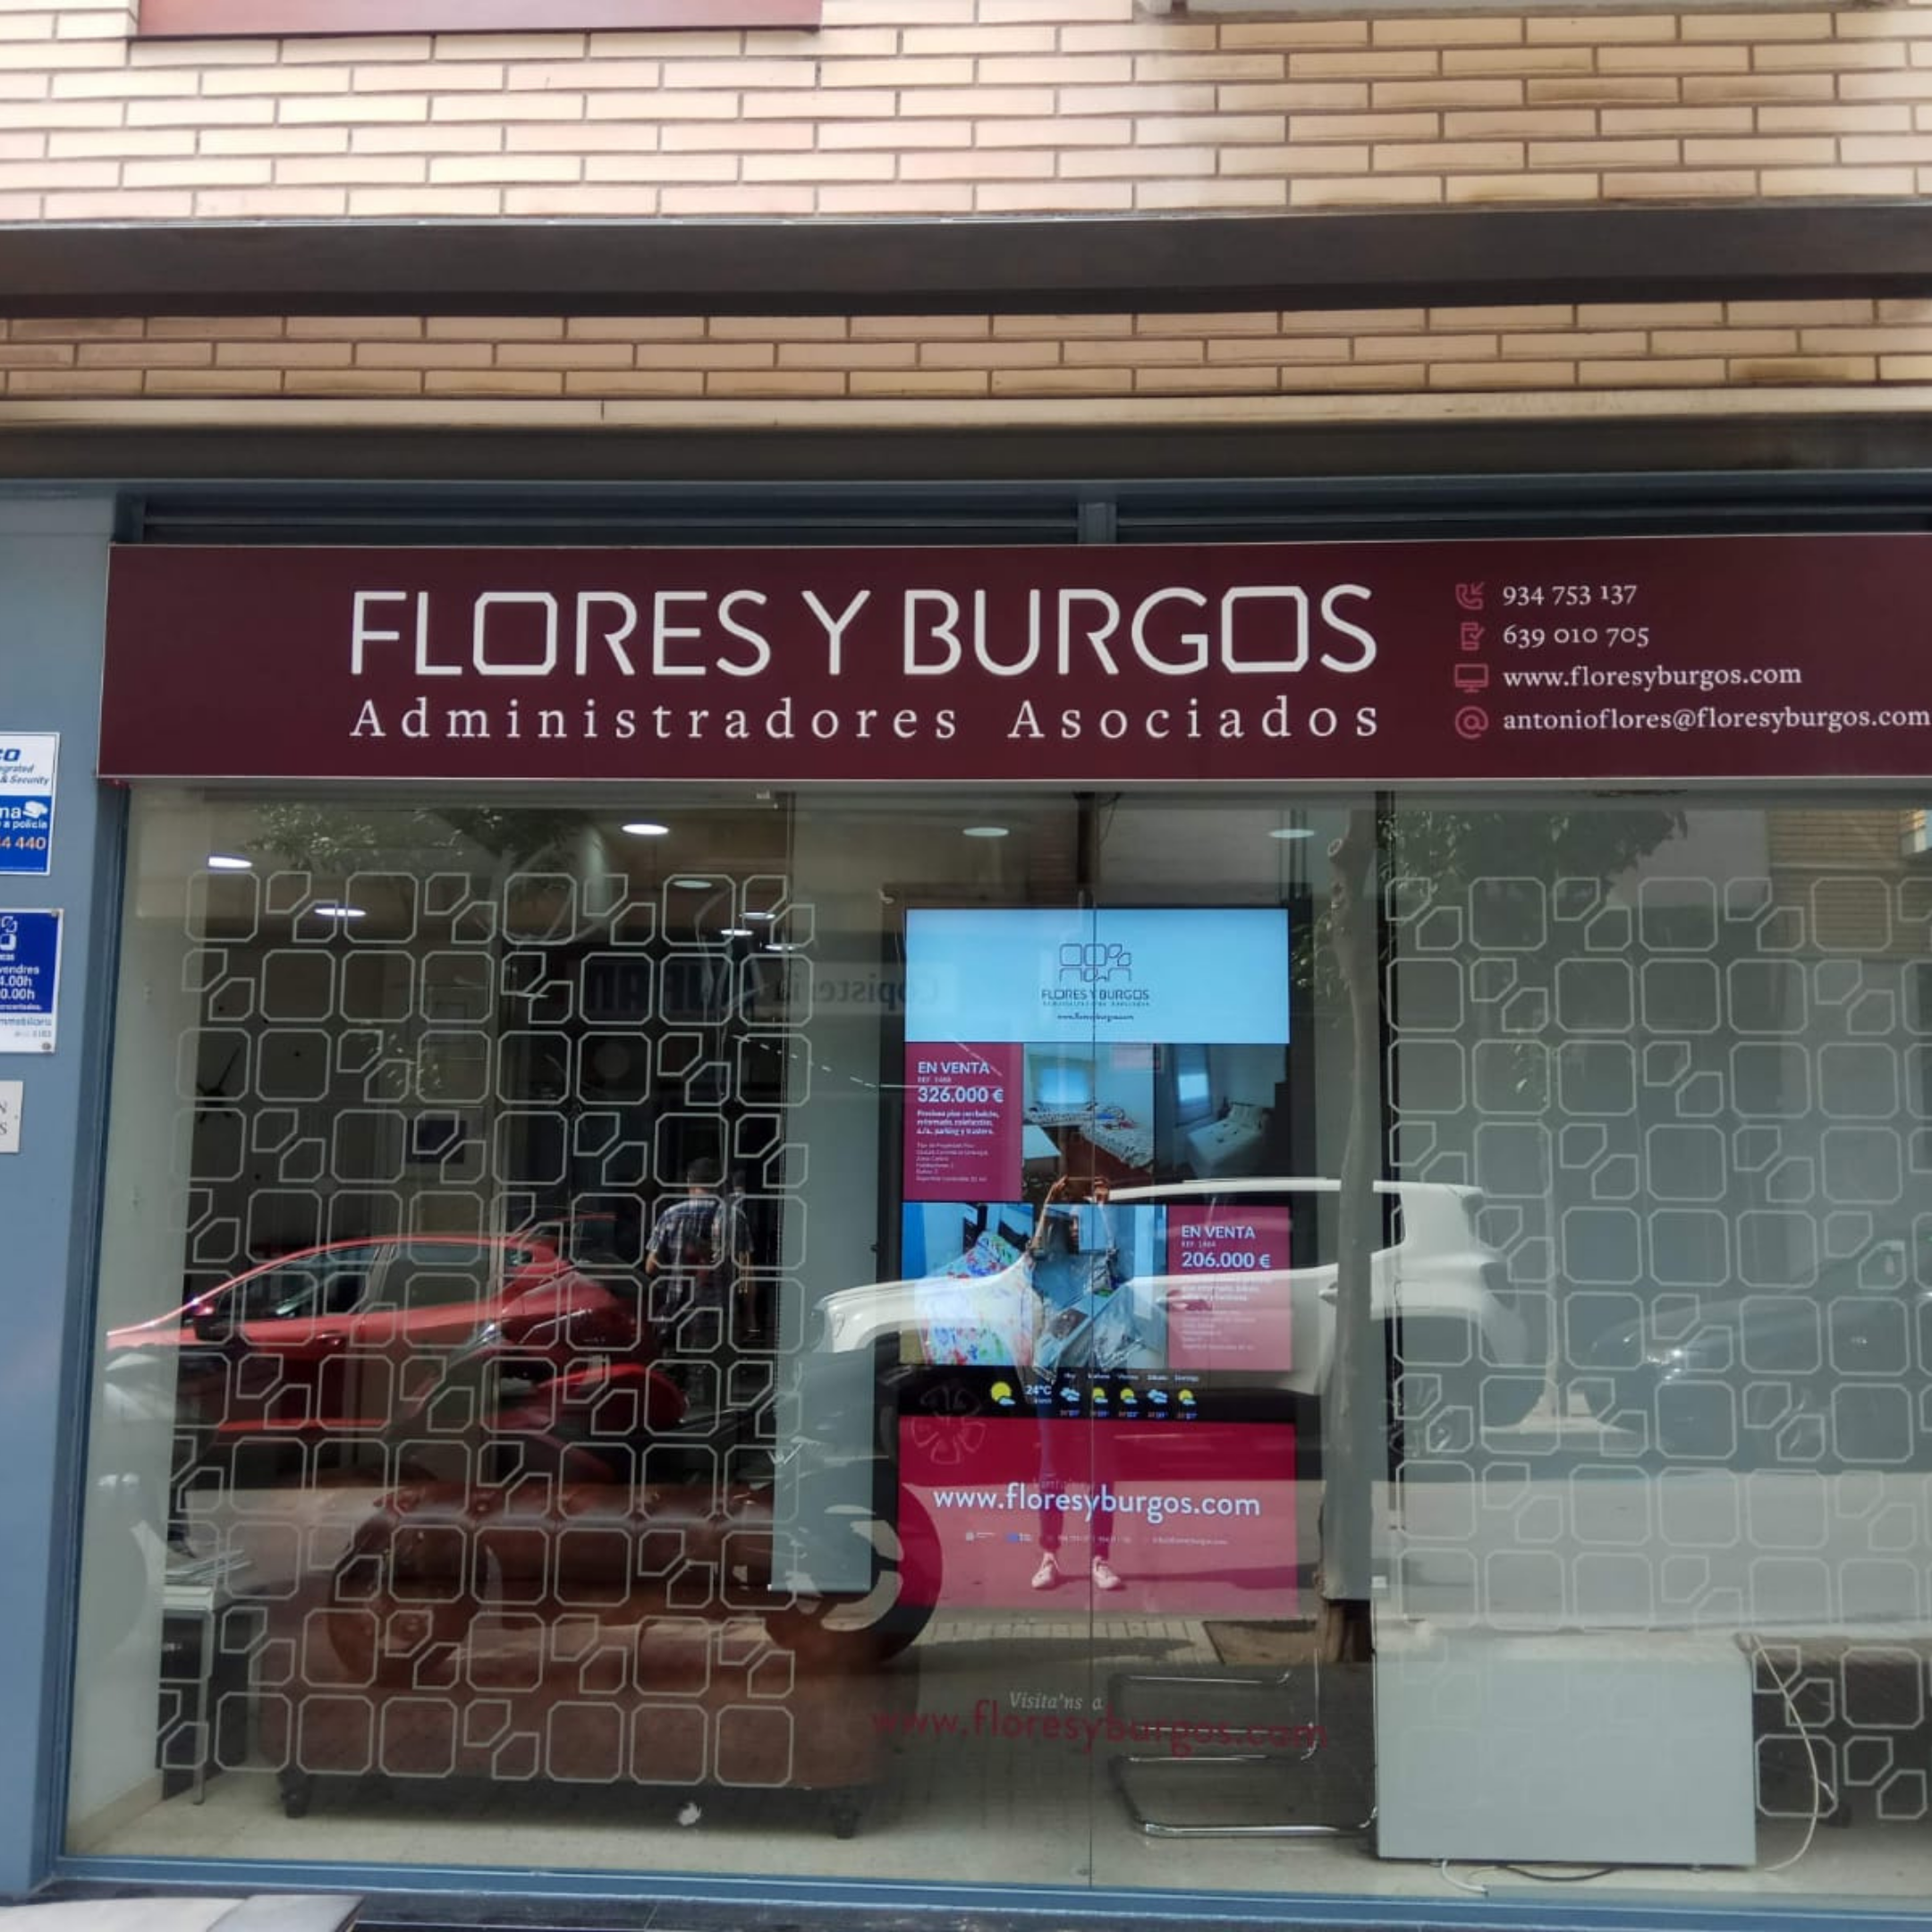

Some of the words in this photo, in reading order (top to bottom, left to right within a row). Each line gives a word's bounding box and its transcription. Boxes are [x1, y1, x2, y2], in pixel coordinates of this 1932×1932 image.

[1503, 587, 1545, 606] 934
[1553, 586, 1591, 606] 753
[1600, 584, 1637, 604] 137
[351, 589, 771, 676] FLORES
[801, 590, 870, 675] Y
[903, 584, 1377, 676] BURGOS
[1503, 625, 1545, 648] 639
[1554, 628, 1597, 644] 010
[1607, 626, 1649, 648] 705
[1503, 665, 1802, 692] www.floresyburgos.com
[350, 696, 956, 739] Administradores
[1007, 695, 1377, 739] Asociados
[1503, 707, 1930, 734] antonioflores@floresyburgos.com
[14, 837, 47, 850] 440
[918, 1062, 937, 1073] EN
[941, 1061, 990, 1074] VENTA
[918, 1087, 988, 1103] 326.000
[993, 1089, 1004, 1103] €
[1182, 1225, 1200, 1238] EN
[1205, 1225, 1256, 1239] VENTA
[1182, 1252, 1255, 1268] 206.000
[1259, 1254, 1271, 1268] €
[933, 1482, 1260, 1523] www.floresyburgos.com
[1010, 1690, 1082, 1710] Visita'ns
[1092, 1698, 1104, 1710] a
[871, 1699, 1327, 1758] www.floresyburgos.com
